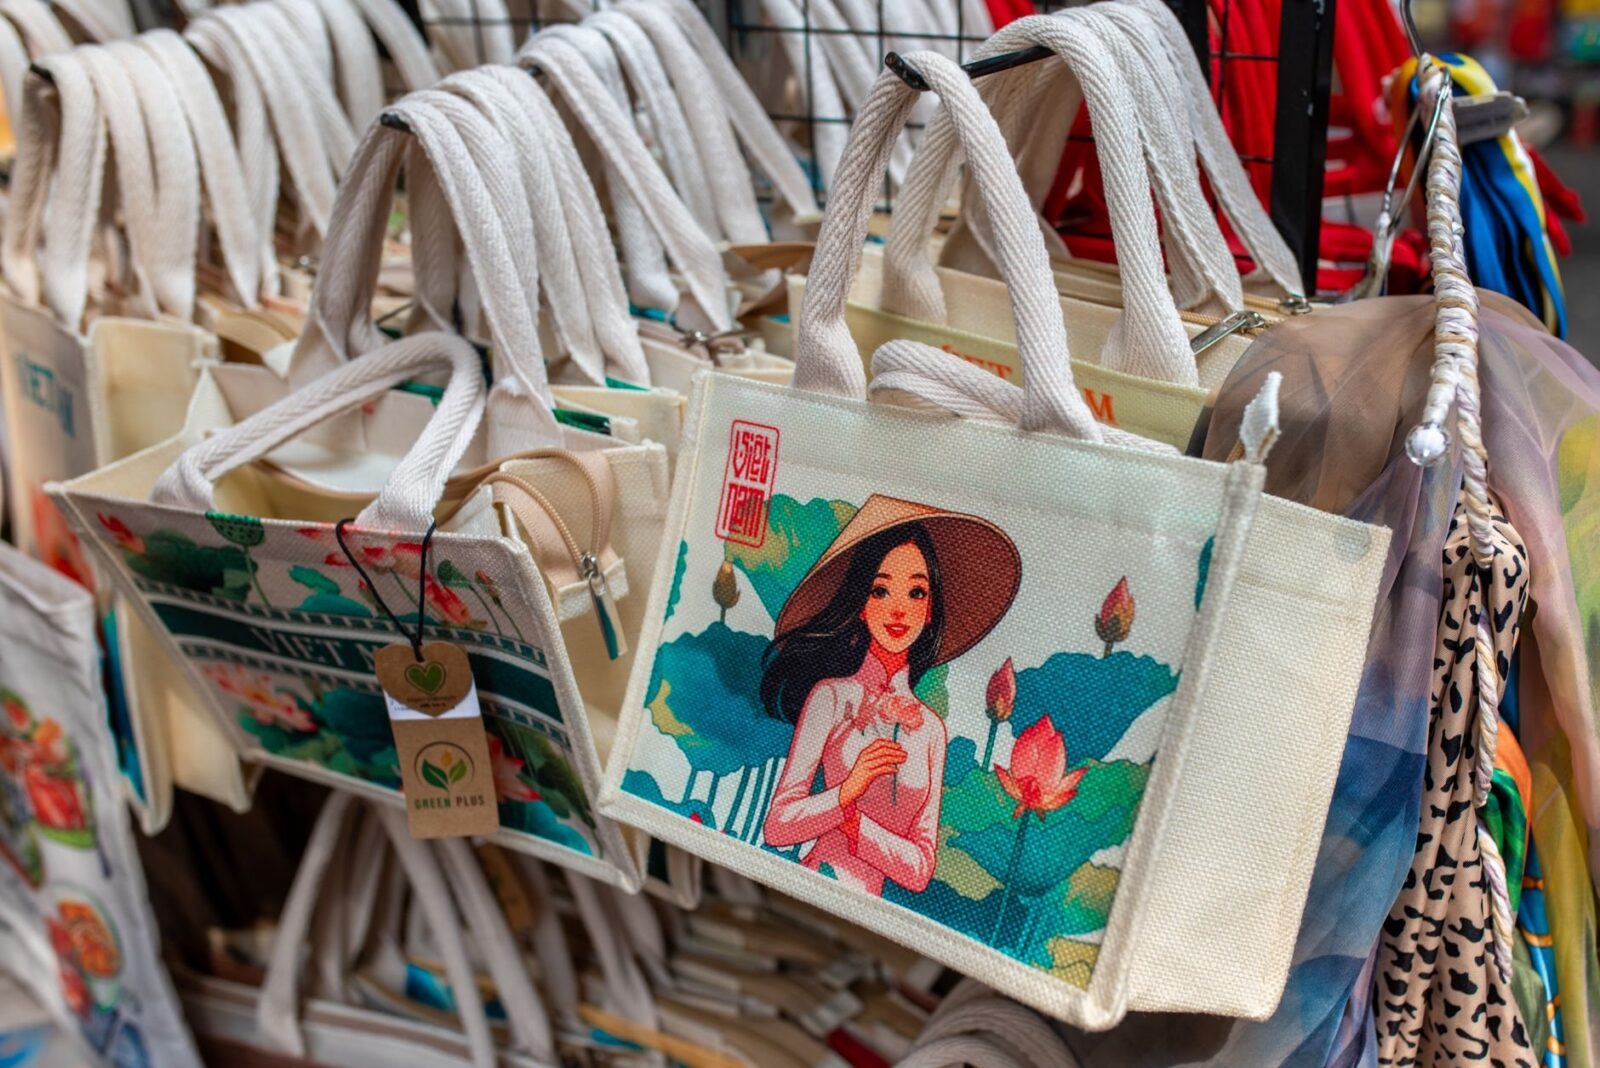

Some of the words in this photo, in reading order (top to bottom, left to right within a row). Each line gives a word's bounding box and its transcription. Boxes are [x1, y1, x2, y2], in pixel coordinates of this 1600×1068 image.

[251, 627, 345, 667] VIET
[414, 797, 452, 811] GREEN
[456, 794, 486, 808] PLUS
